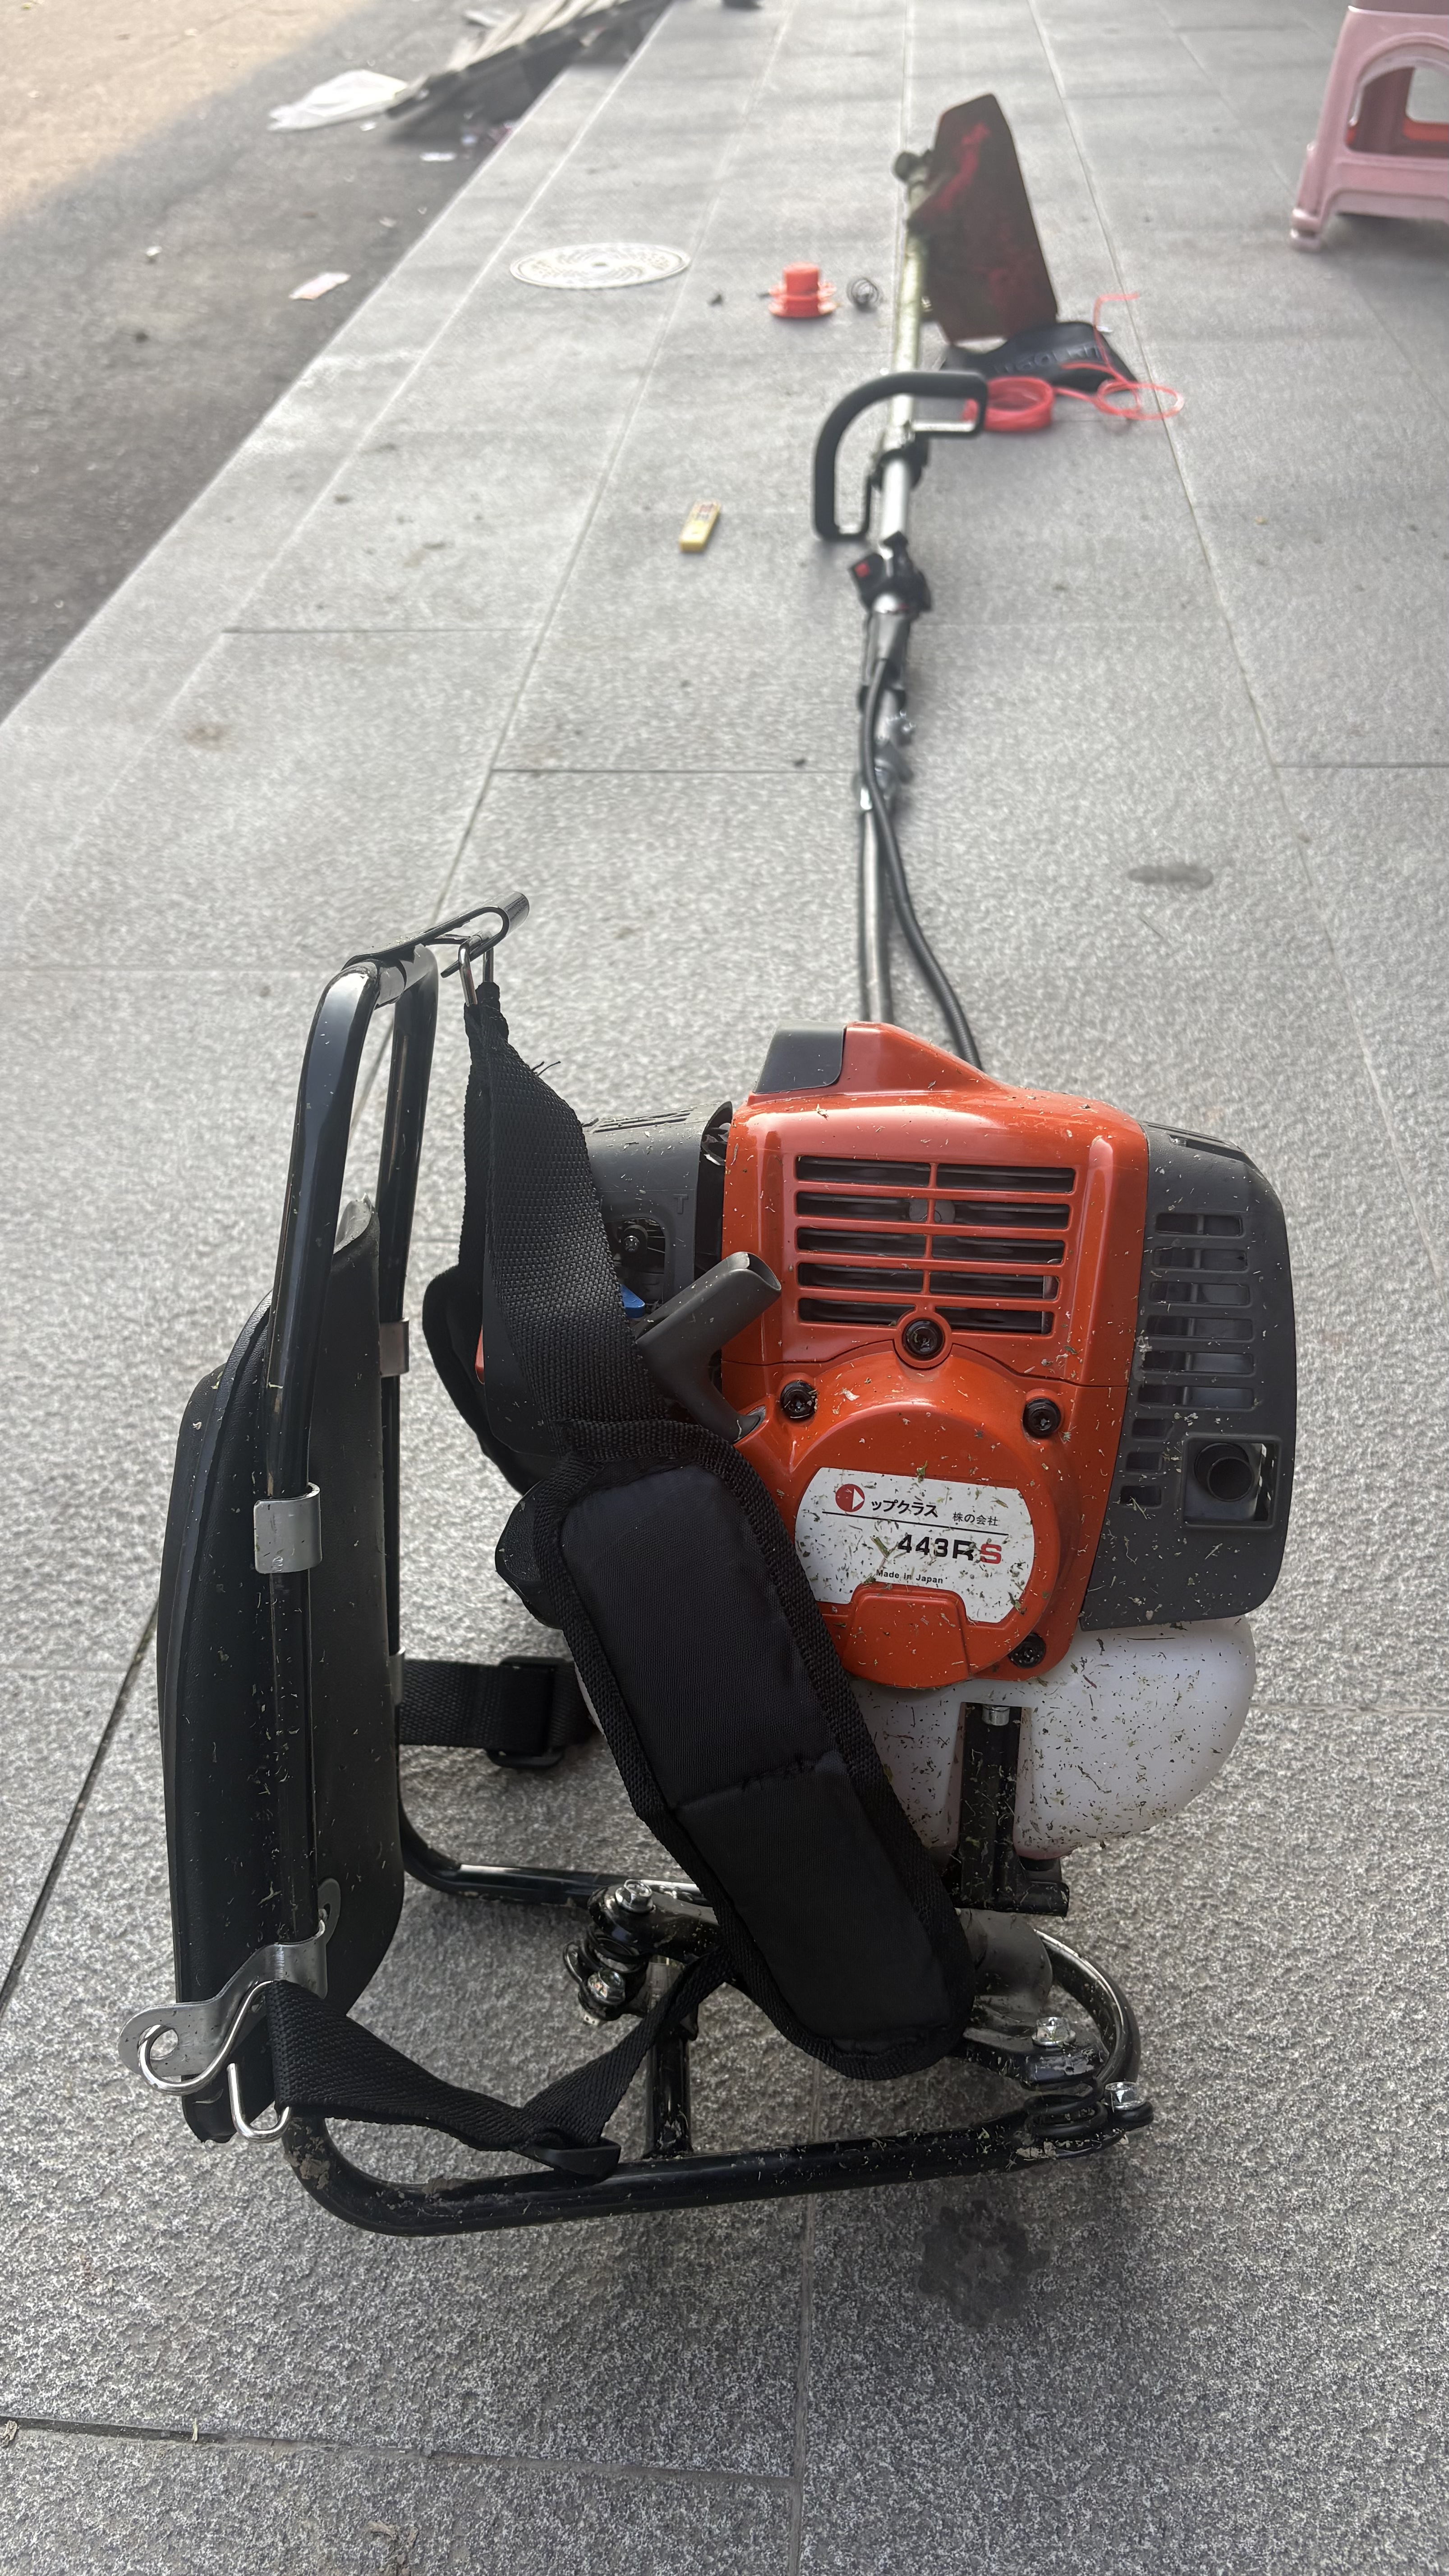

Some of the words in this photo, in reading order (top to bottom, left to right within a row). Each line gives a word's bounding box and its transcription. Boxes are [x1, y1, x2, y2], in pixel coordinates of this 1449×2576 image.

[952, 1511, 998, 1527] 株の会社
[897, 1534, 1002, 1564] 443RS
[876, 1569, 900, 1579] Made
[904, 1573, 912, 1581] in
[916, 1574, 943, 1584] Japan
